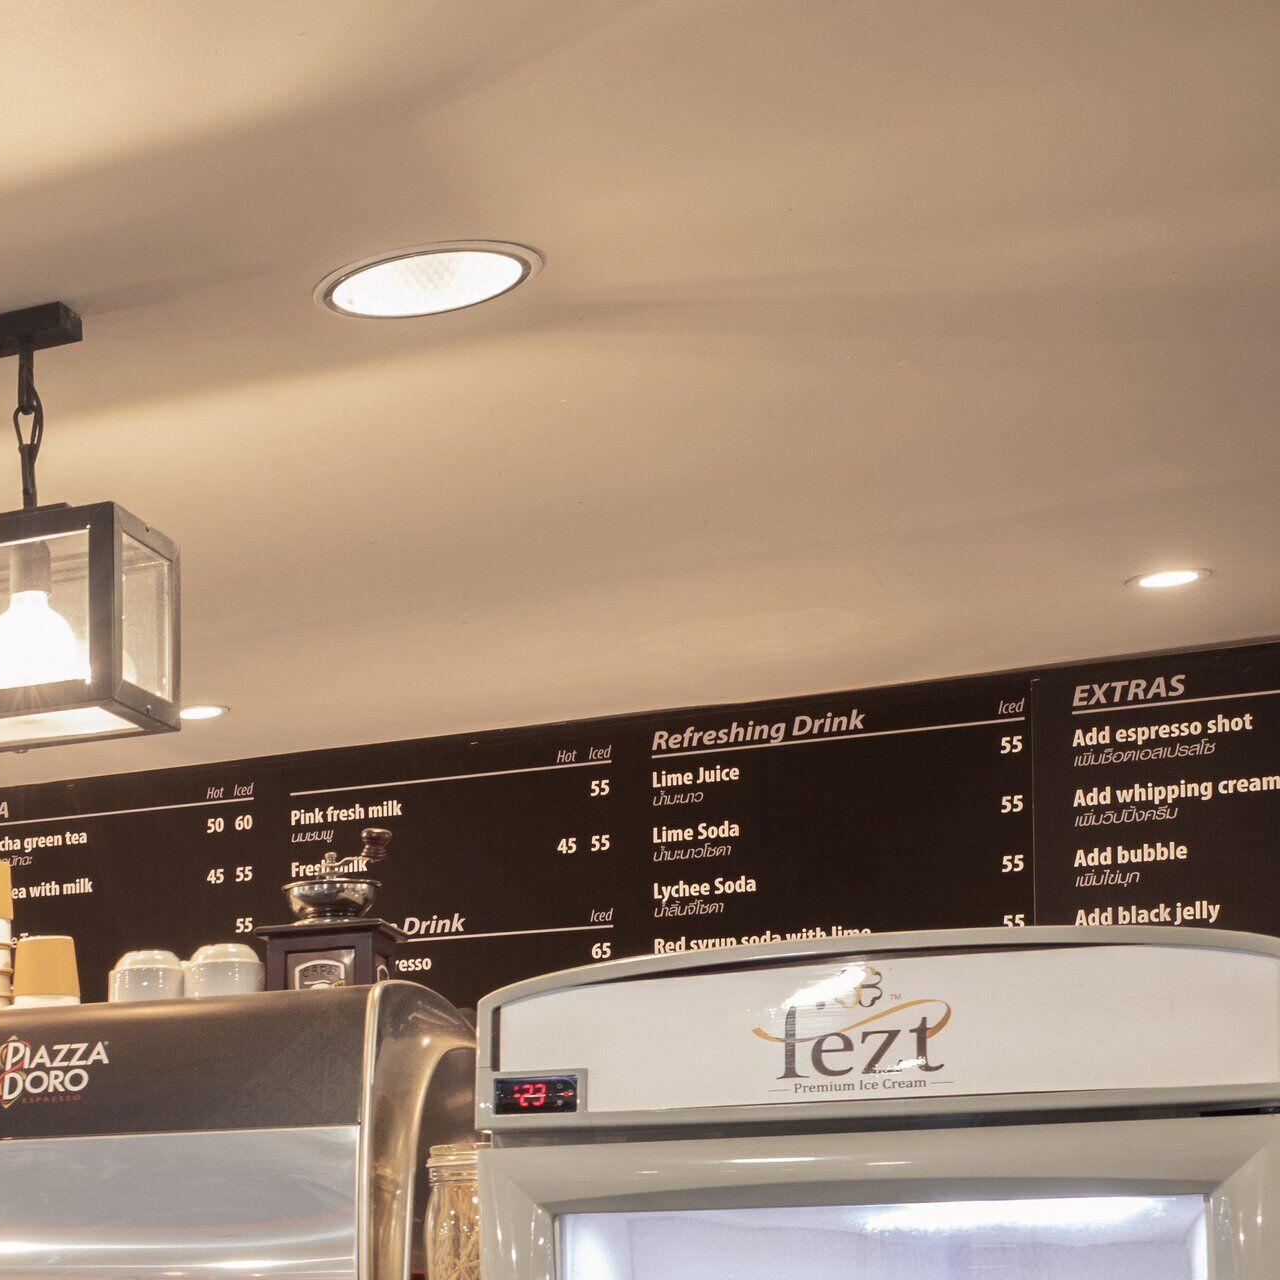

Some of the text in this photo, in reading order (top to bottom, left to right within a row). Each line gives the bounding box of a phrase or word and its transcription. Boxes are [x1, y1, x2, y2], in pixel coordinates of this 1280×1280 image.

[1072, 674, 1186, 707] EXTRAS
[999, 698, 1024, 715] Iced
[652, 709, 866, 751] Refreshing Drink
[1072, 713, 1253, 747] Add espresso shot
[1000, 735, 1023, 754] 55
[557, 745, 612, 764] Hot Iced
[652, 765, 740, 788] Lime Juice
[206, 782, 253, 800] Hot Iced
[590, 780, 610, 798] 55
[653, 791, 704, 806] น้ำมะนาว
[1073, 775, 1280, 807] Add whipping cream
[291, 800, 402, 826] Pink fresh milk
[1001, 795, 1024, 814] 55
[207, 815, 253, 834] 50 60
[652, 820, 740, 844] Lime Soda
[24, 834, 62, 853] green
[65, 831, 88, 845] tea
[291, 830, 334, 843] นมชมพู
[557, 835, 610, 854] 45 55
[1002, 854, 1024, 873] 55
[1074, 842, 1188, 868] Add bubble
[207, 866, 253, 885] 45 55
[29, 881, 59, 898] with
[62, 878, 93, 895] milk
[653, 875, 757, 903] Lychee Soda
[590, 908, 613, 922] Iced
[1075, 900, 1221, 927] Add black jelly
[235, 918, 253, 933] 55
[403, 913, 466, 935] Drink
[591, 943, 611, 959] 65
[654, 937, 686, 954] Red
[3, 1040, 109, 1071] PIAZZA
[793, 1079, 927, 1094] Premium Ice Cream
